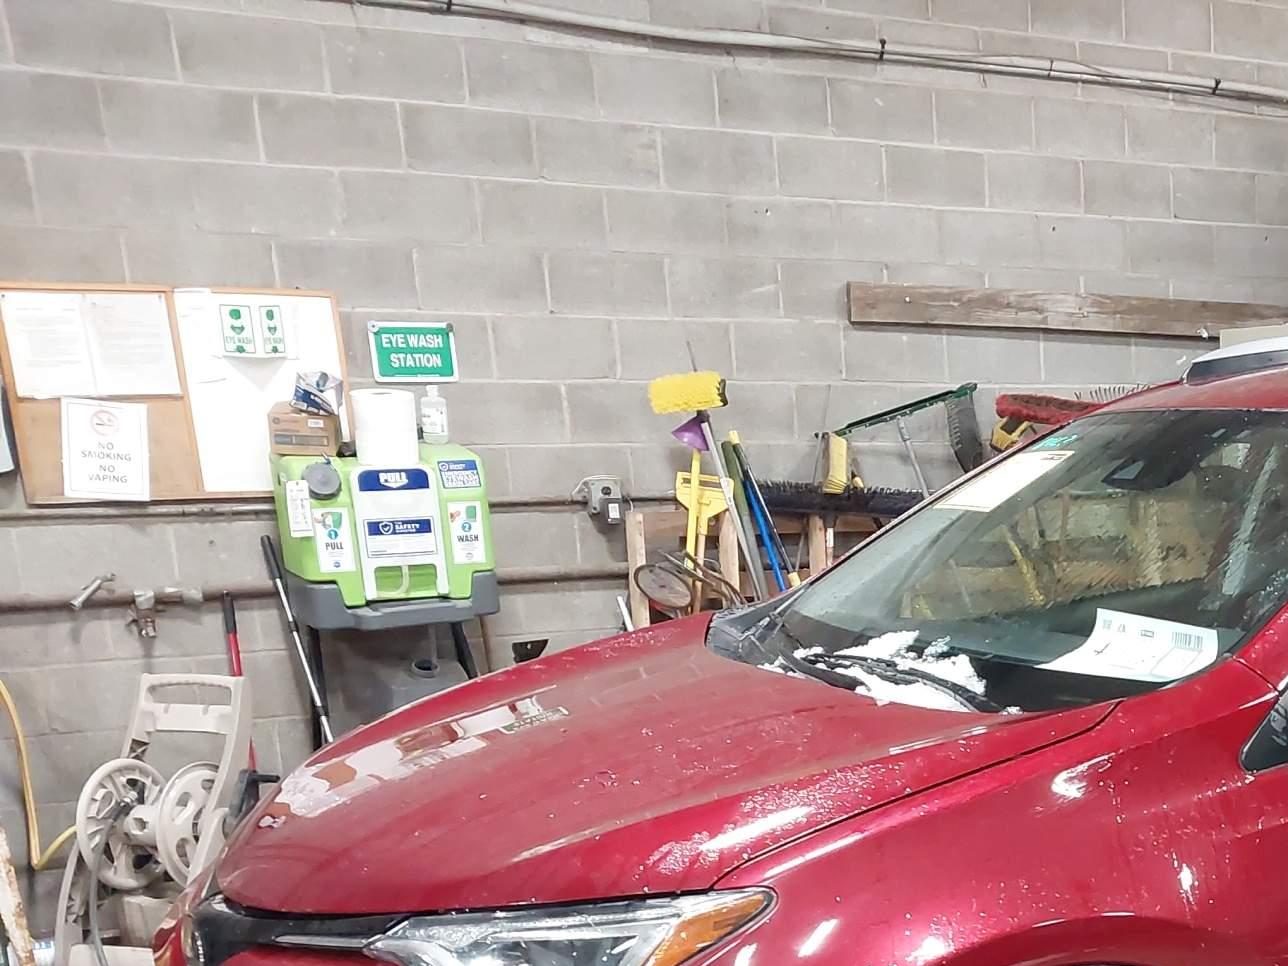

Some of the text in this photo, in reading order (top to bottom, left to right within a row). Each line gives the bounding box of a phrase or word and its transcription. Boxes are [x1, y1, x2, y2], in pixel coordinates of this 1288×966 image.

[381, 333, 444, 348] EYE WASH
[389, 353, 442, 368] STATION
[98, 442, 114, 450] NO
[80, 450, 132, 462] SMOKING
[99, 464, 115, 473] NO
[88, 474, 128, 483] VAPING
[379, 472, 406, 483] PULL
[457, 534, 479, 542] WASH
[325, 541, 344, 550] PULL
